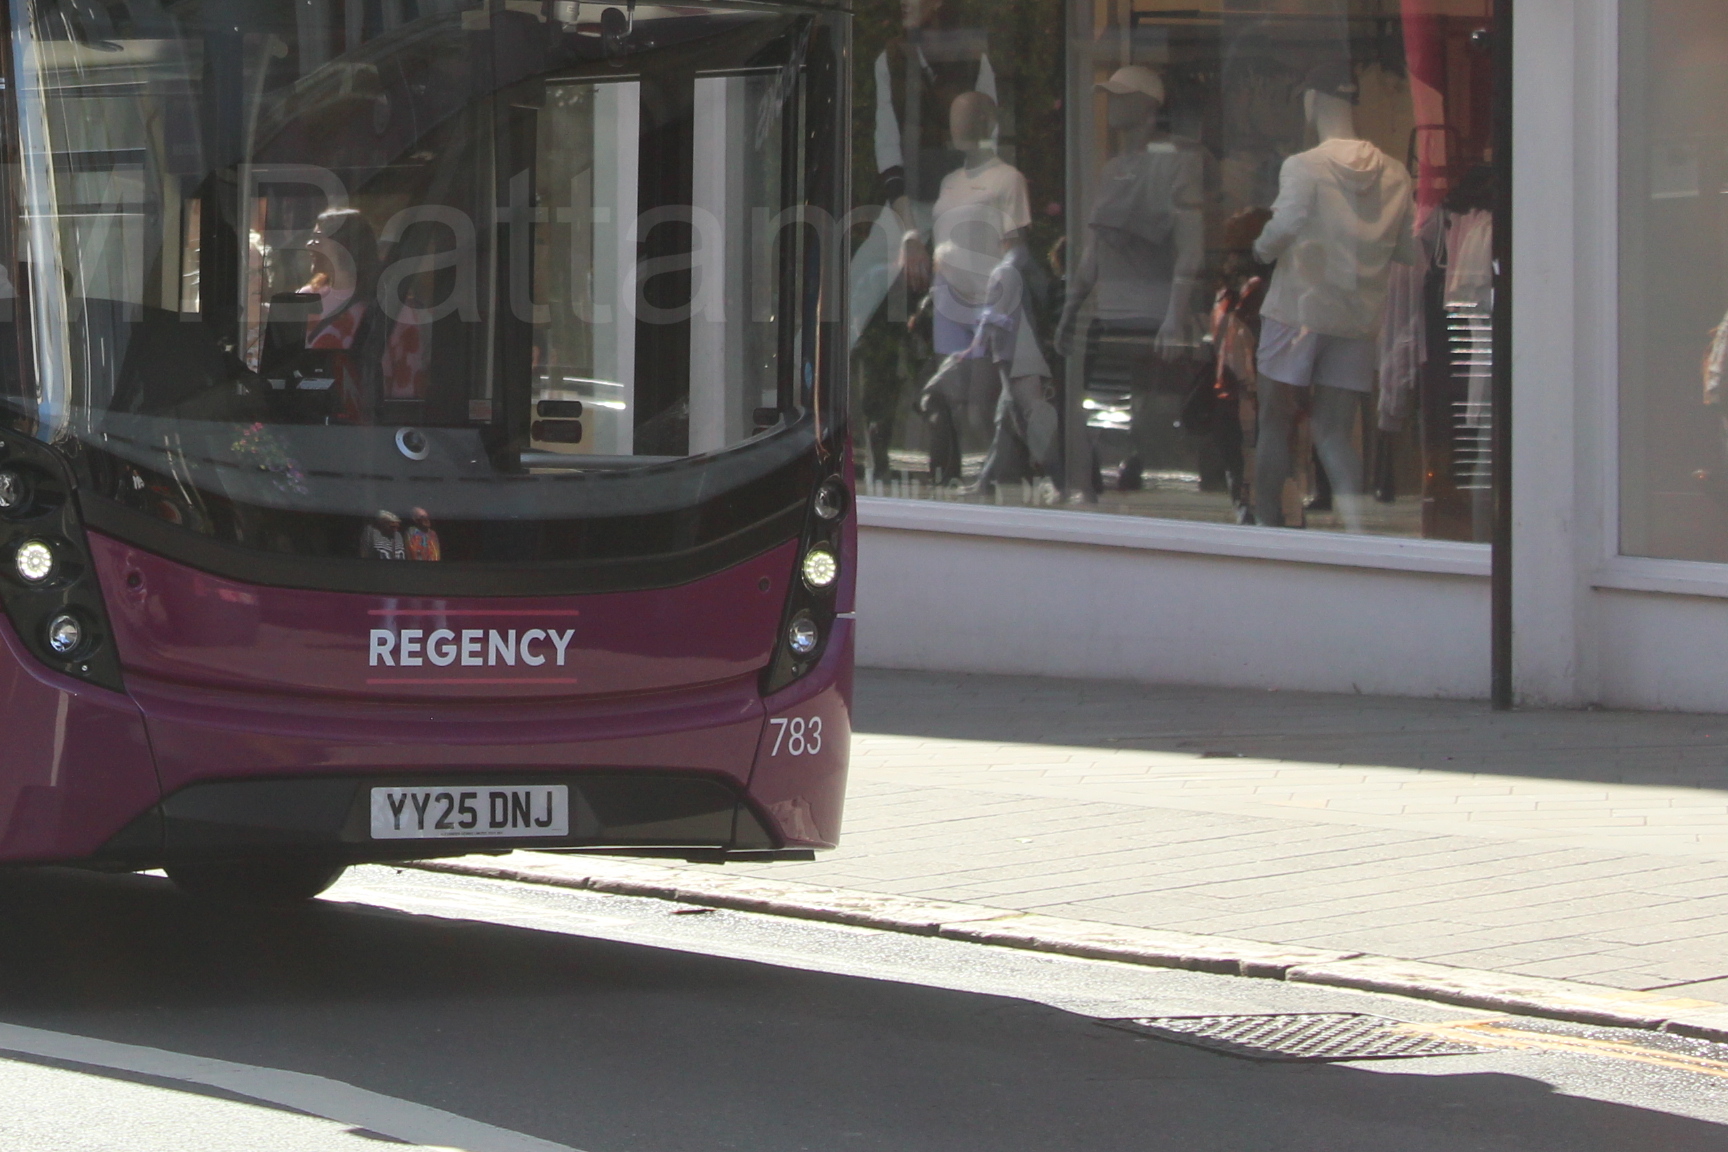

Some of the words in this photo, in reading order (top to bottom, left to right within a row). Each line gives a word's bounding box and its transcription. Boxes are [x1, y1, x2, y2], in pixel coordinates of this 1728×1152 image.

[369, 628, 576, 668] REGENCY
[770, 715, 823, 757] 783
[386, 792, 478, 831] YY25
[489, 791, 553, 829] DNJ
